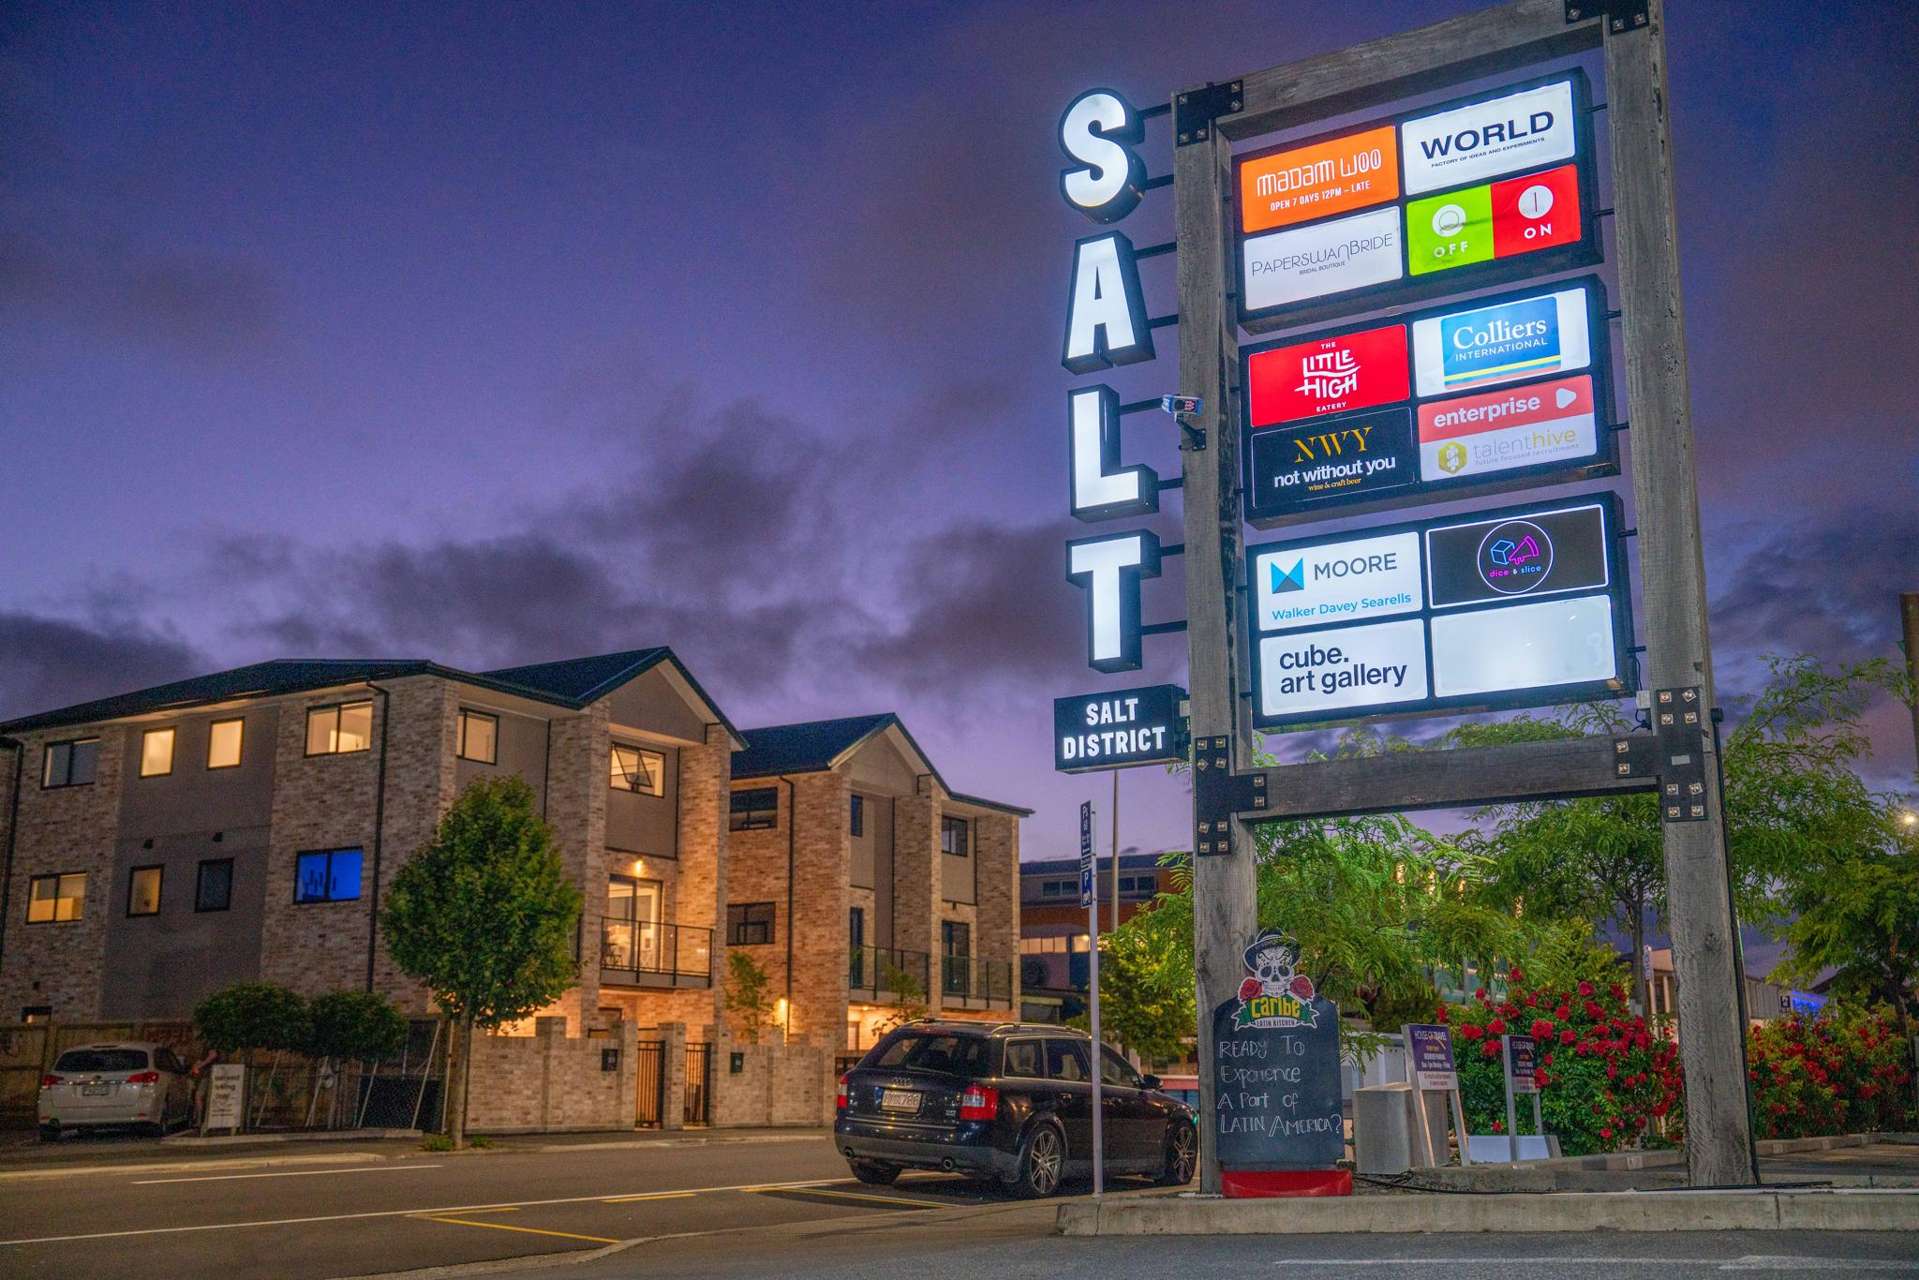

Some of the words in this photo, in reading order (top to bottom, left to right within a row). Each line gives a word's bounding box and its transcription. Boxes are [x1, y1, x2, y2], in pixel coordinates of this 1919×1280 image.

[1421, 111, 1554, 160] WORLD
[1431, 158, 1459, 168] FACTORY
[1468, 151, 1487, 159] IDEAS
[1488, 147, 1501, 155] AND
[1502, 137, 1545, 151] EXPERIMENTS
[1270, 197, 1290, 211] OPEN
[1292, 196, 1297, 207] 7
[1299, 192, 1320, 205] DAYS
[1321, 187, 1342, 201] 12PM
[1351, 181, 1371, 196] LATE
[1523, 223, 1553, 240] ON
[1433, 241, 1469, 258] OFF
[1318, 261, 1346, 271] BOUTIQUE
[1320, 341, 1336, 349] THE
[1453, 319, 1547, 350] Colliers
[1302, 349, 1358, 375] LITTLE
[1455, 338, 1548, 361] INTERNATIONAL
[1063, 92, 1141, 661] SALT
[1294, 371, 1358, 399] HIGH
[1316, 401, 1347, 413] EATERY
[1433, 395, 1541, 428] enterprise
[1294, 426, 1373, 463] NWY
[1473, 429, 1577, 458] talenthive
[1273, 472, 1300, 488] not
[1302, 460, 1363, 483] without
[1366, 456, 1396, 475] you
[1331, 480, 1346, 488] craft
[1346, 478, 1361, 486] beer
[1314, 552, 1398, 581] MOORE
[1489, 568, 1510, 578] dice
[1520, 565, 1542, 574] slice
[1272, 605, 1316, 621] Walker
[1319, 601, 1358, 619] Davey
[1361, 592, 1412, 610] Searells
[1279, 643, 1349, 670] cube.
[1280, 669, 1315, 694] art
[1321, 662, 1408, 694] gallery
[1086, 698, 1139, 726] SALT
[1063, 726, 1166, 760] DISTRICT
[1219, 1041, 1268, 1059] READY
[1220, 1065, 1301, 1088] Experience
[1217, 1093, 1233, 1109] A
[1282, 1092, 1300, 1114] of
[1220, 1114, 1265, 1134] LATIN
